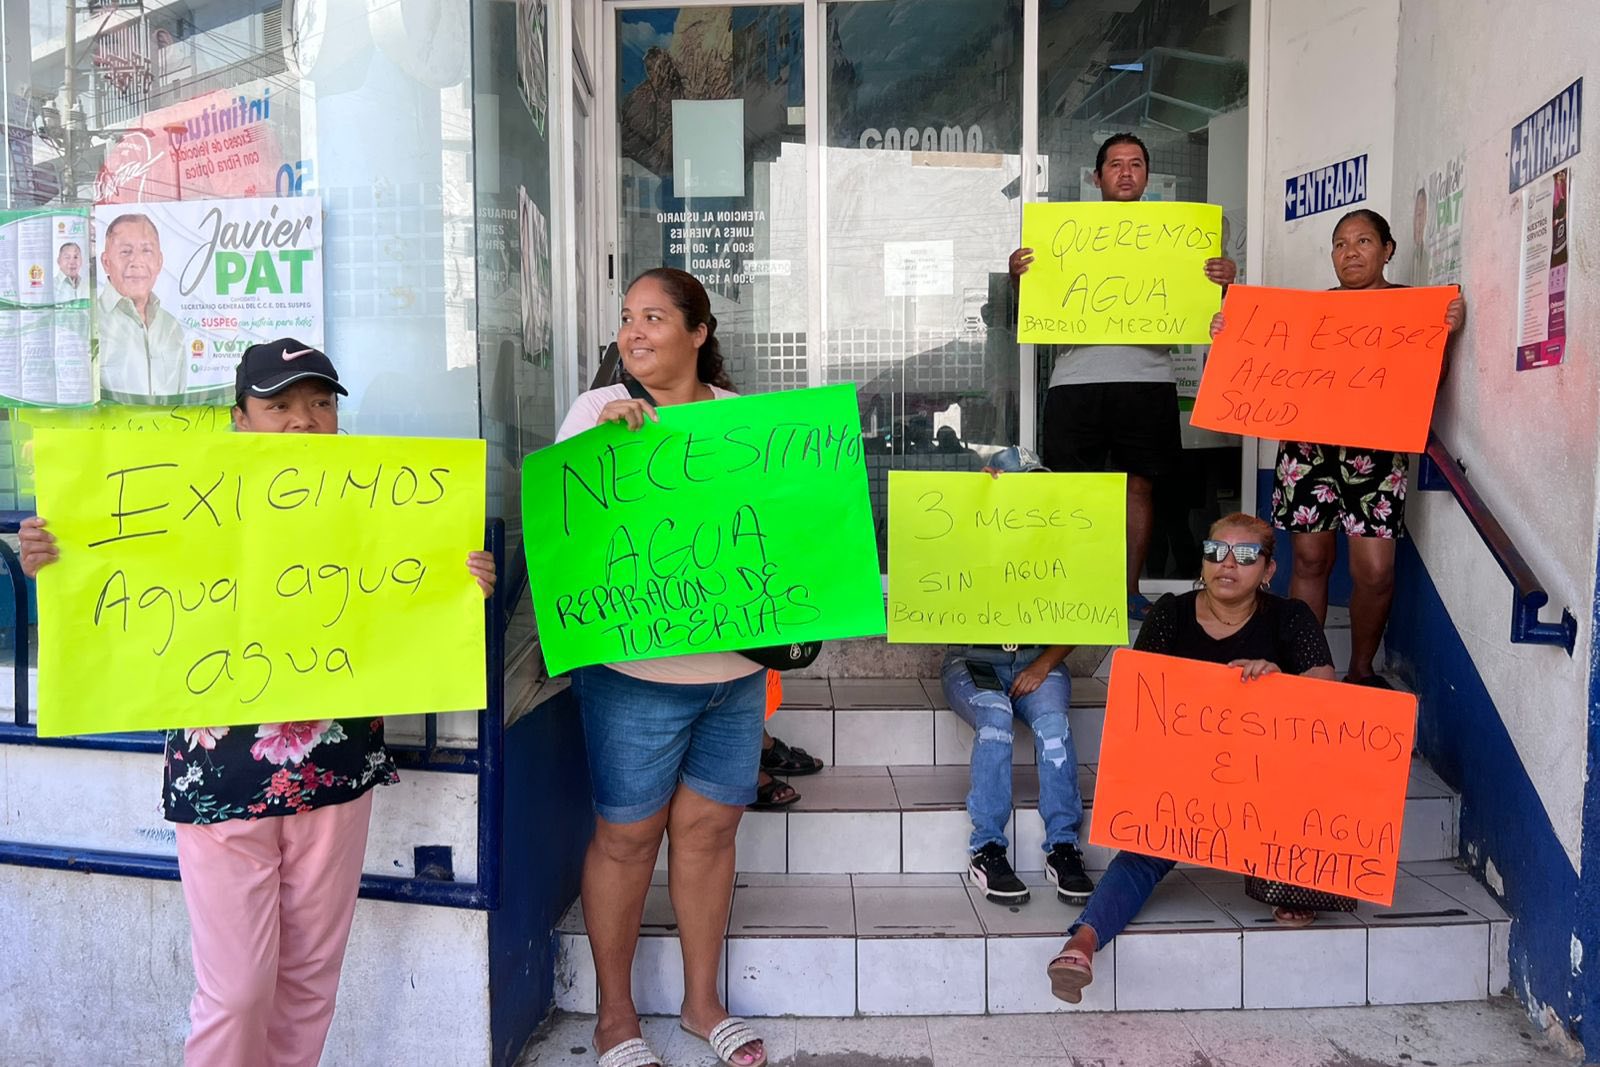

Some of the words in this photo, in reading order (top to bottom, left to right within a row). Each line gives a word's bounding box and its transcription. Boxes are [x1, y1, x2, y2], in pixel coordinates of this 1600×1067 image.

[1520, 84, 1578, 186] ENTRADA
[1296, 156, 1365, 217] ENTRADA
[180, 204, 313, 296] Javier
[1052, 219, 1217, 272] QUEREMOS
[215, 249, 313, 295] PAT
[1062, 273, 1168, 314] AGUA
[202, 318, 238, 327] SUSPEG
[1023, 316, 1087, 333] BARRIO
[1236, 305, 1289, 351] LA
[1348, 366, 1387, 389] LA
[89, 463, 449, 547] EXIGIMOS
[914, 490, 954, 539] 3
[975, 507, 1092, 532] MESES
[606, 505, 767, 589] AGUA
[737, 563, 780, 605] DE
[919, 571, 973, 592] SIN
[1004, 558, 1067, 583] AGUA
[95, 570, 237, 655] Agua
[276, 558, 426, 628] agua
[893, 600, 967, 625] Barrio
[978, 601, 1010, 627] de
[1033, 597, 1120, 628] PINZONA
[186, 642, 354, 703] agua
[1135, 672, 1405, 761] NECESITAMOS
[1109, 811, 1229, 866] GUINEA
[1303, 808, 1394, 853] AGUA
